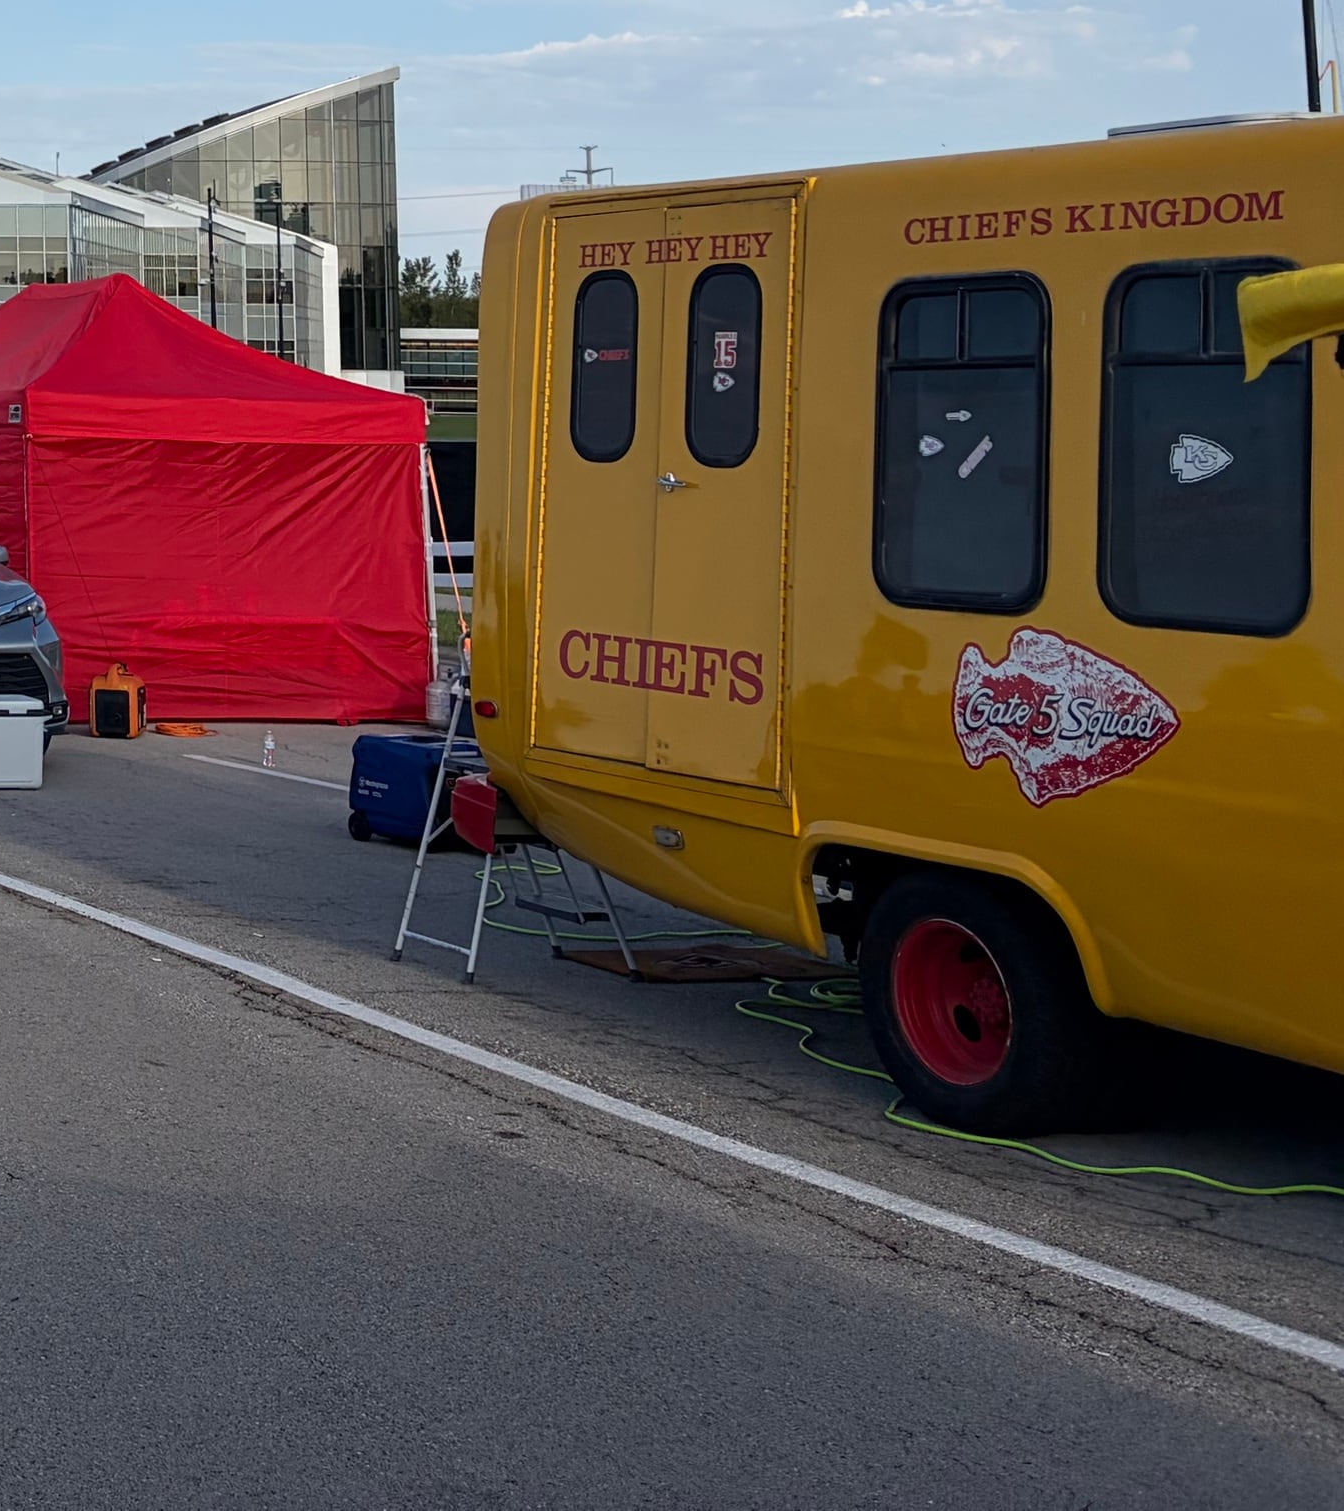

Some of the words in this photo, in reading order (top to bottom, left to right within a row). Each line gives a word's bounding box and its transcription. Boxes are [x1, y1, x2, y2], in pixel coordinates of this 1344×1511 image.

[904, 208, 1053, 245] CHIEFS
[1065, 190, 1285, 233] KINGDOM
[578, 242, 635, 268] HEY
[645, 237, 704, 264] HEY
[708, 232, 773, 260] HEY
[714, 340, 737, 368] 15
[1185, 445, 1218, 470] KC
[559, 629, 764, 705] CHIEFS
[963, 687, 1034, 730] Gate
[1031, 694, 1064, 736] 5
[1058, 697, 1163, 748] Squad
